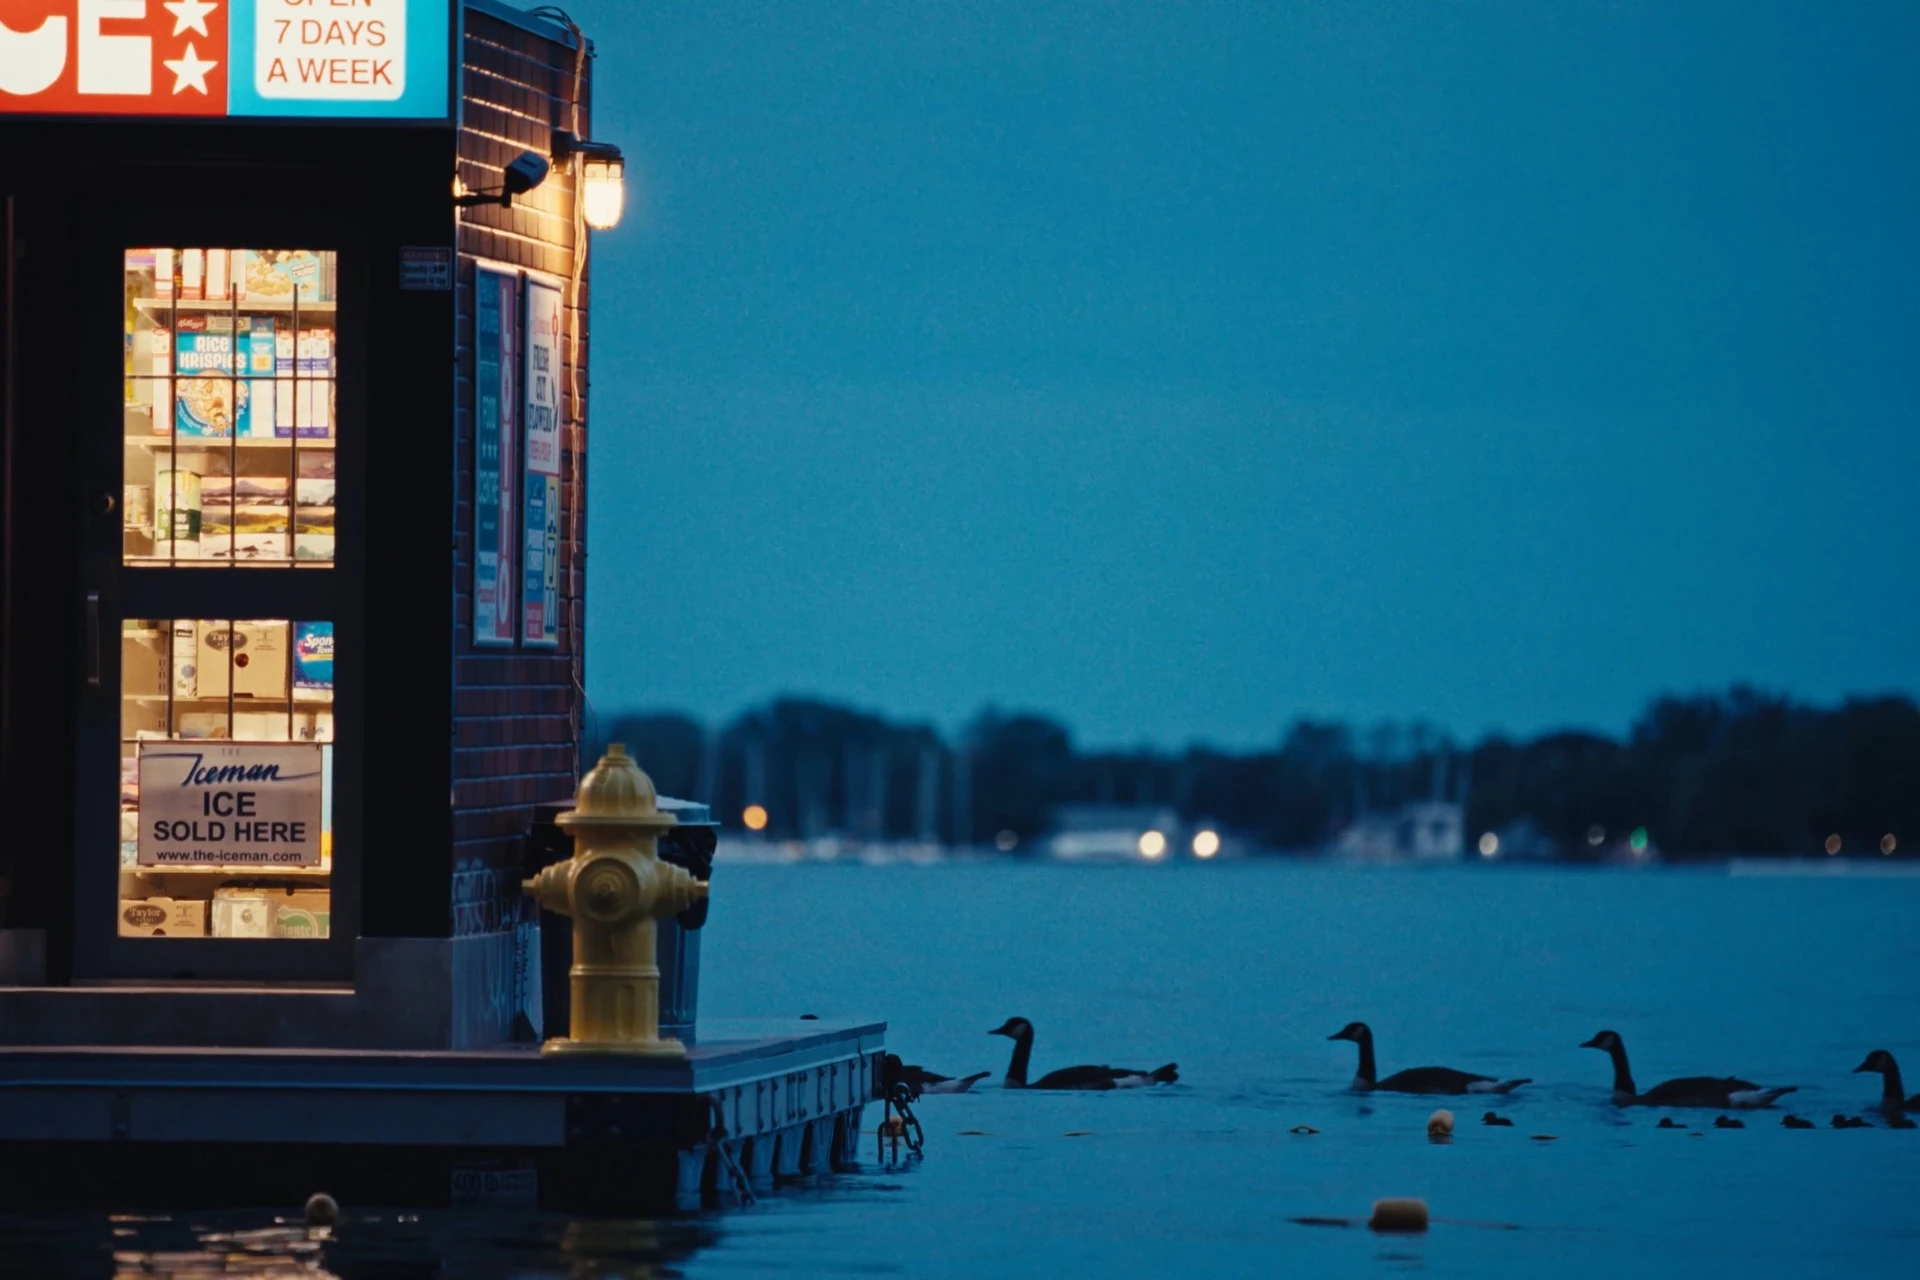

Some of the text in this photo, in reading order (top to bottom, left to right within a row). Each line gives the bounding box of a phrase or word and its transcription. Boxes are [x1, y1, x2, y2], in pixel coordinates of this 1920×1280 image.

[274, 19, 386, 46] 7 DAYS
[267, 57, 393, 85] A WEEK
[203, 791, 257, 817] ICE
[153, 820, 306, 843] SOLD HERE
[156, 849, 302, 862] www.the-iceman.com
